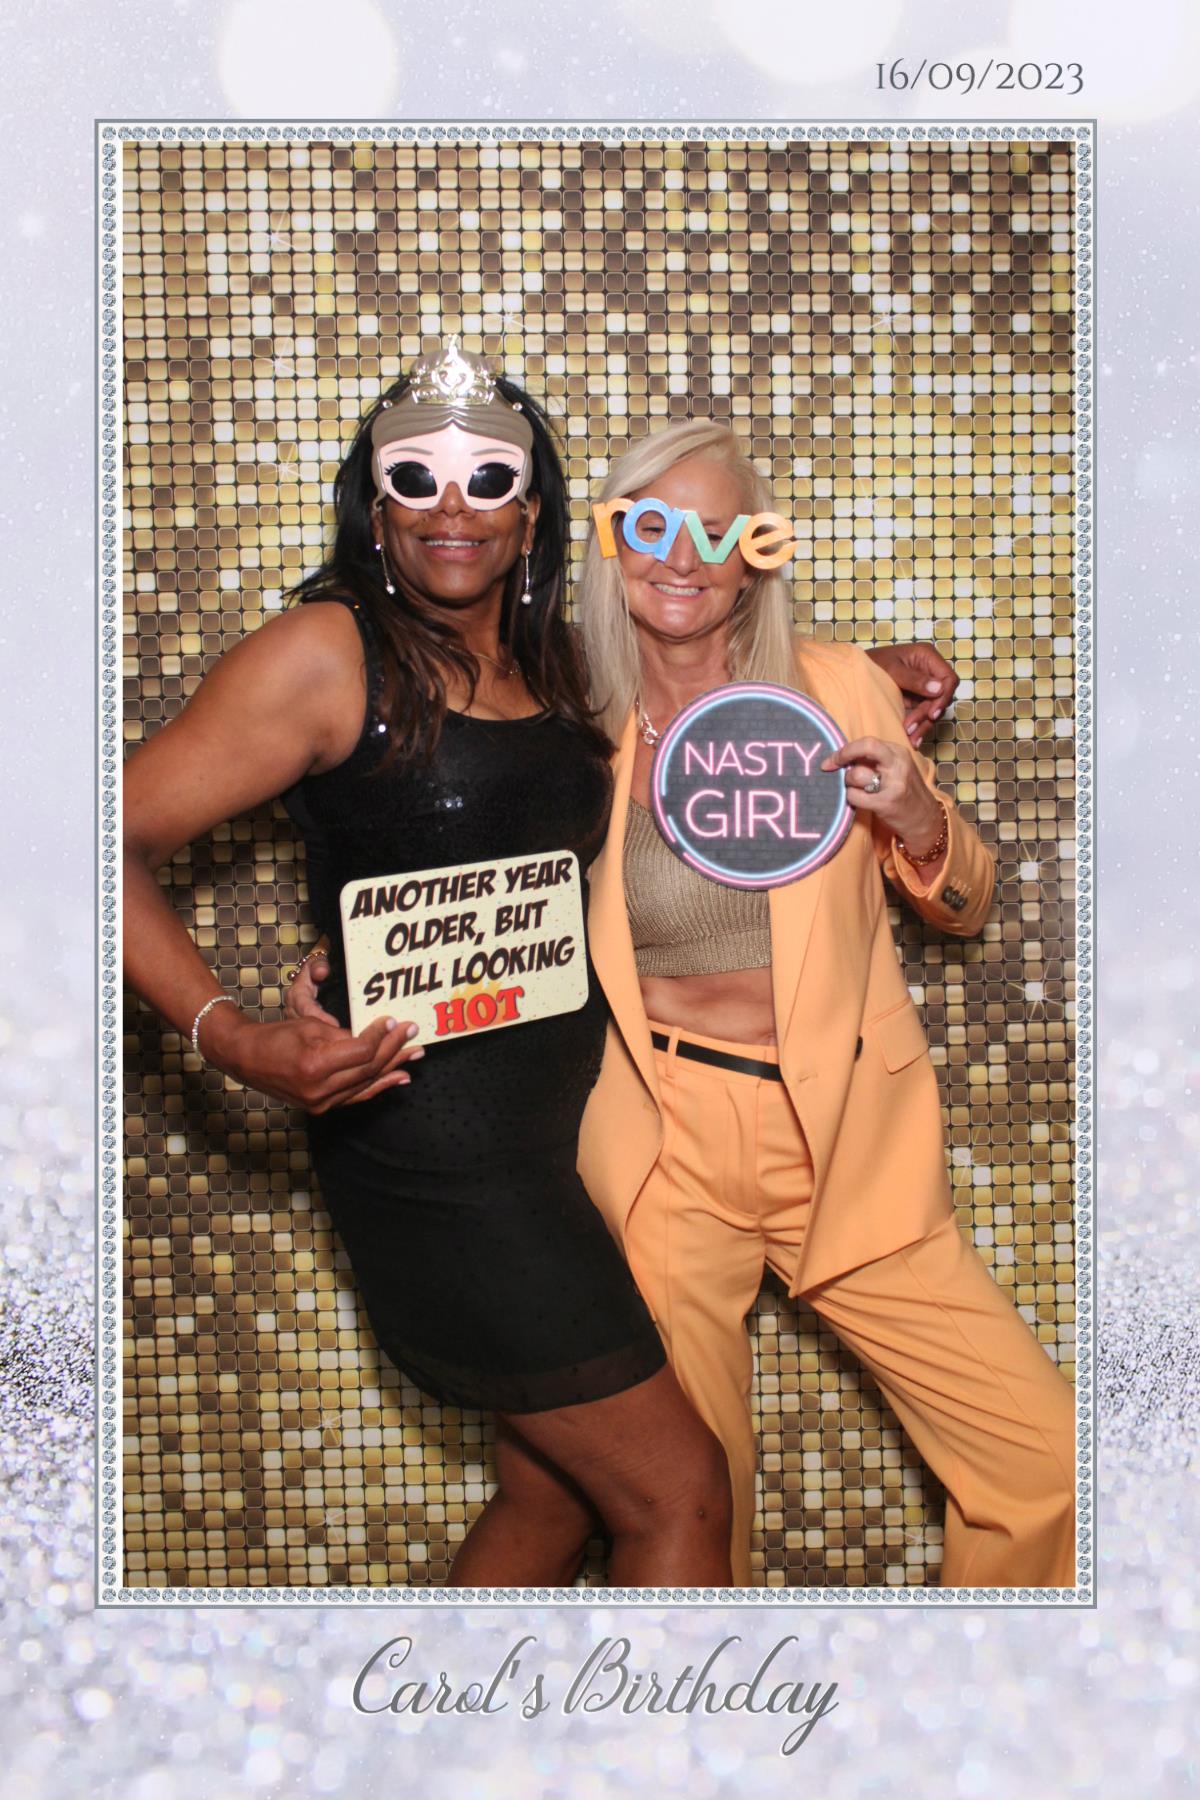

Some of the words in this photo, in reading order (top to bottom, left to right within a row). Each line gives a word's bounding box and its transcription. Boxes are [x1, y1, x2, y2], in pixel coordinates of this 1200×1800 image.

[684, 741, 822, 777] NASTY
[685, 789, 821, 839] GIRL
[349, 869, 497, 921] ANOTHER
[504, 857, 574, 895] YEAR
[385, 911, 486, 957] OLDER,
[494, 899, 549, 937] BUT
[363, 962, 443, 1007] STILL
[451, 936, 576, 988] LOOKING
[433, 986, 525, 1037] HOT
